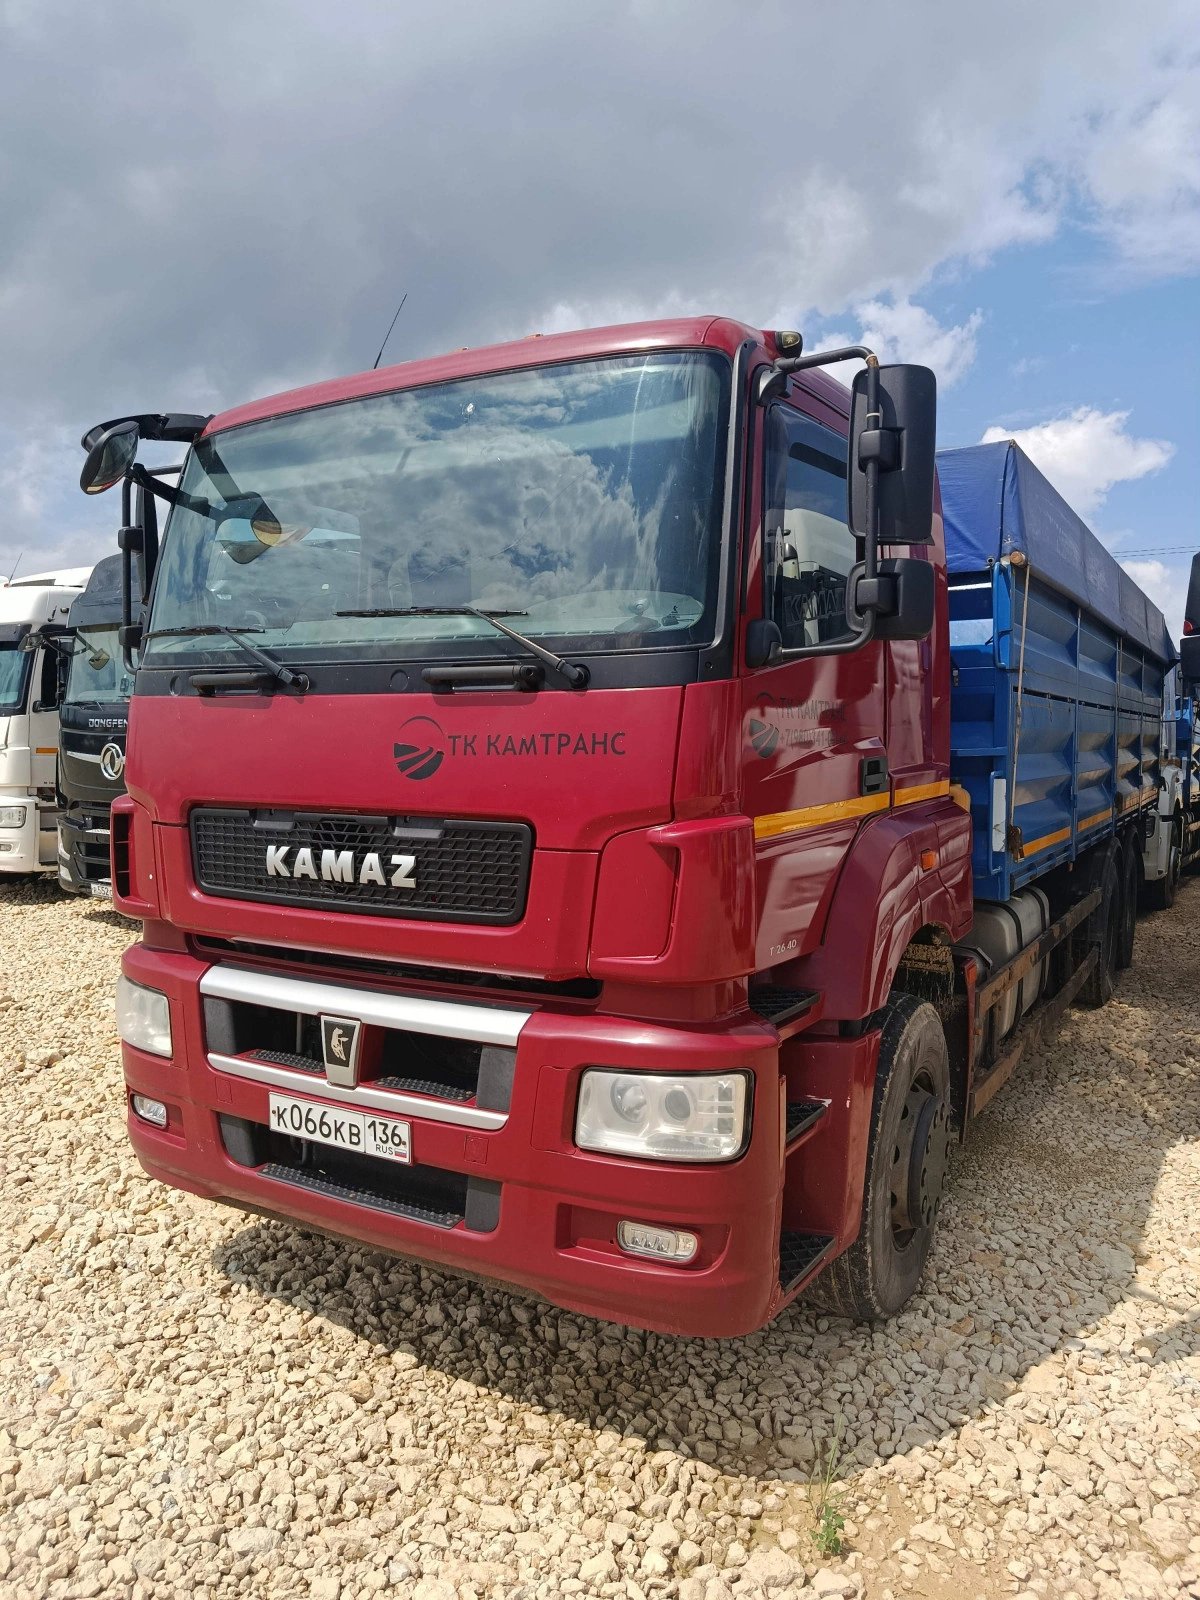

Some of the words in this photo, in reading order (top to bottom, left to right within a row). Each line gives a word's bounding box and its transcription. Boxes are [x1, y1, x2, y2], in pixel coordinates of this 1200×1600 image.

[88, 718, 128, 728] DONGFEN
[447, 734, 477, 756] ТК
[486, 732, 626, 756] КАМТРАНС
[266, 845, 417, 889] KAMAZ
[367, 1120, 402, 1147] 136
[375, 1143, 394, 1155] RUS
